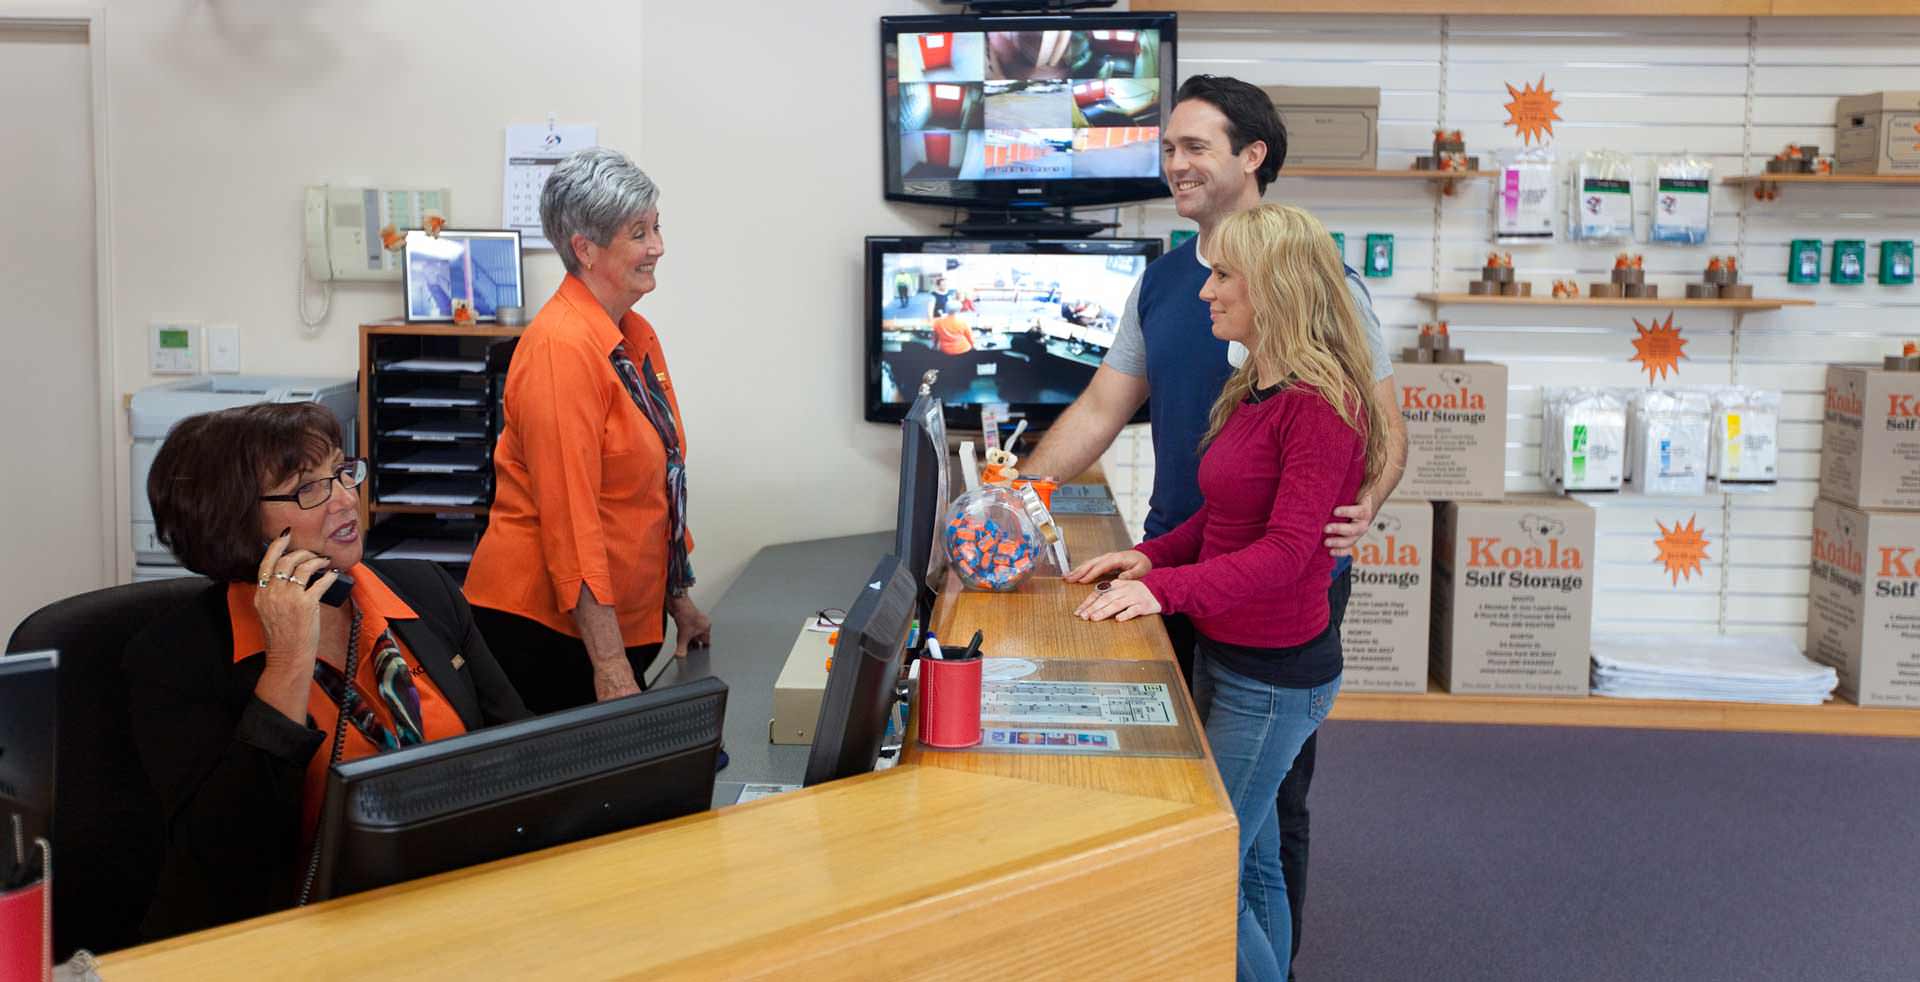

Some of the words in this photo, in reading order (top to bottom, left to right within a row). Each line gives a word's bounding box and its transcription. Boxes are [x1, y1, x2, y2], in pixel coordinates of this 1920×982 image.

[1402, 386, 1485, 410] Koala
[1402, 410, 1428, 422] Self
[1432, 411, 1486, 425] Storage
[1466, 537, 1583, 569] Koala
[1812, 528, 1862, 575] Koala
[1465, 571, 1503, 588] Self
[1509, 572, 1583, 592] Storage
[1876, 580, 1917, 597] Self
